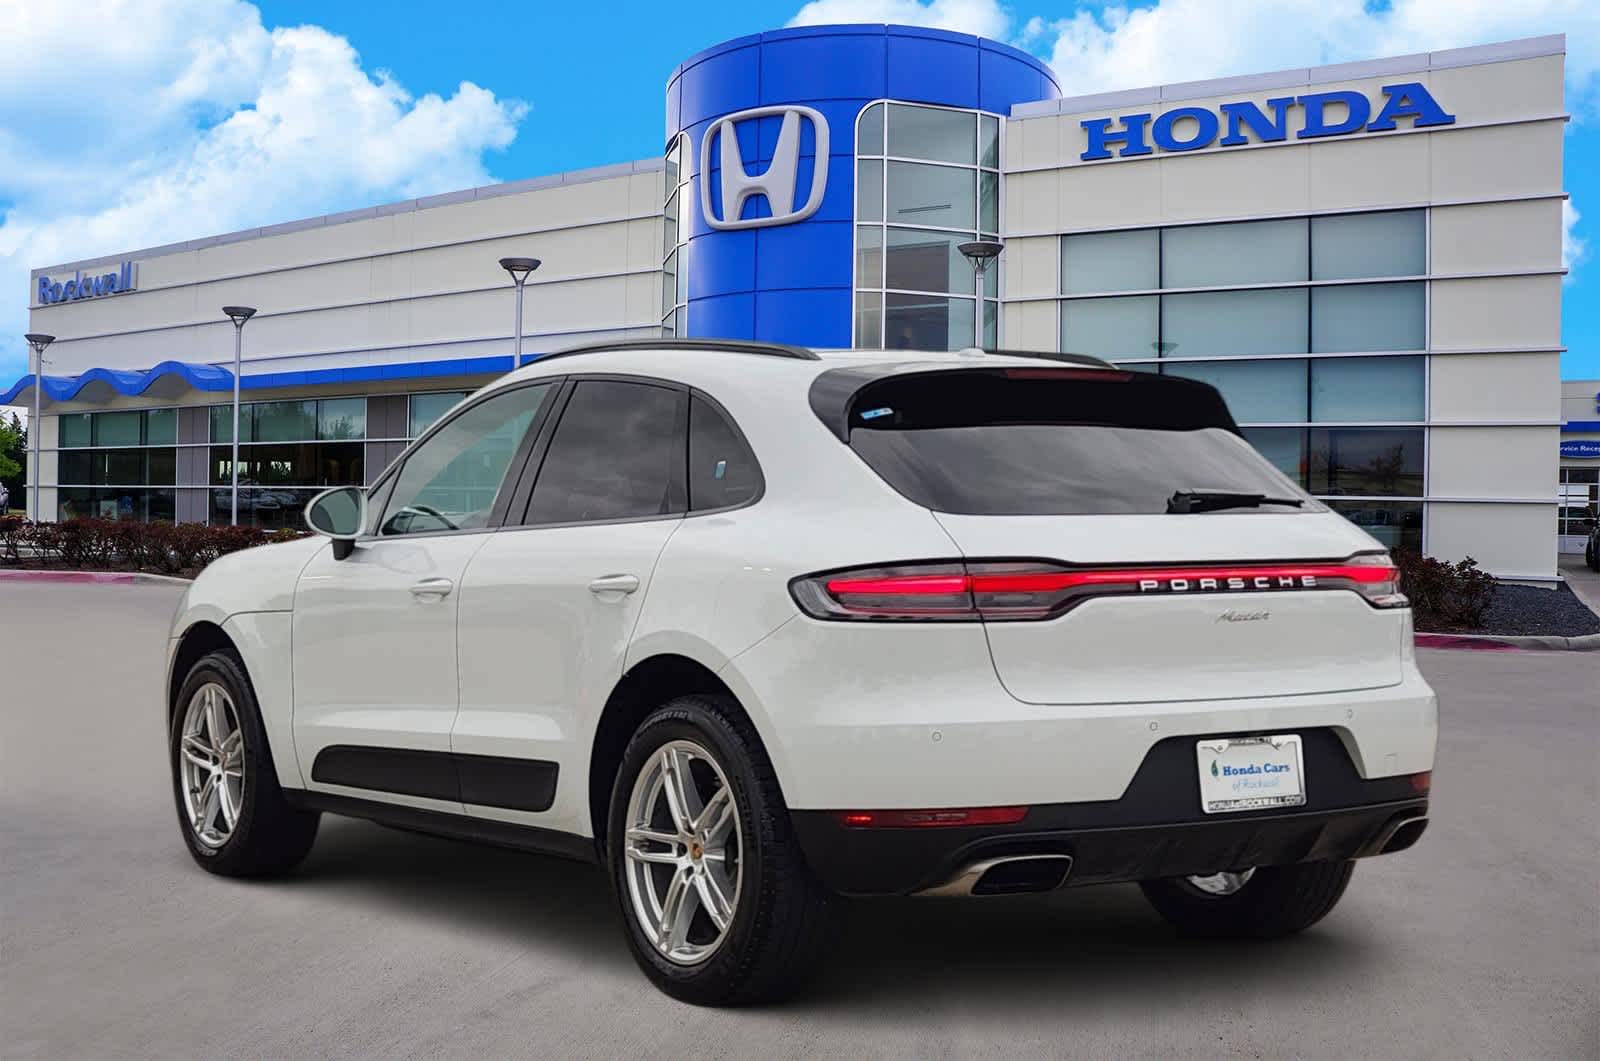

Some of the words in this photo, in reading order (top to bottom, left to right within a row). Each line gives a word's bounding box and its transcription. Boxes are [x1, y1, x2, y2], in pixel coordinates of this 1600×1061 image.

[1080, 82, 1456, 161] HONDA
[39, 261, 132, 304] Rockwall
[1139, 576, 1318, 592] PORSCHE
[1223, 763, 1262, 776] Honda
[1263, 762, 1290, 773] Cars
